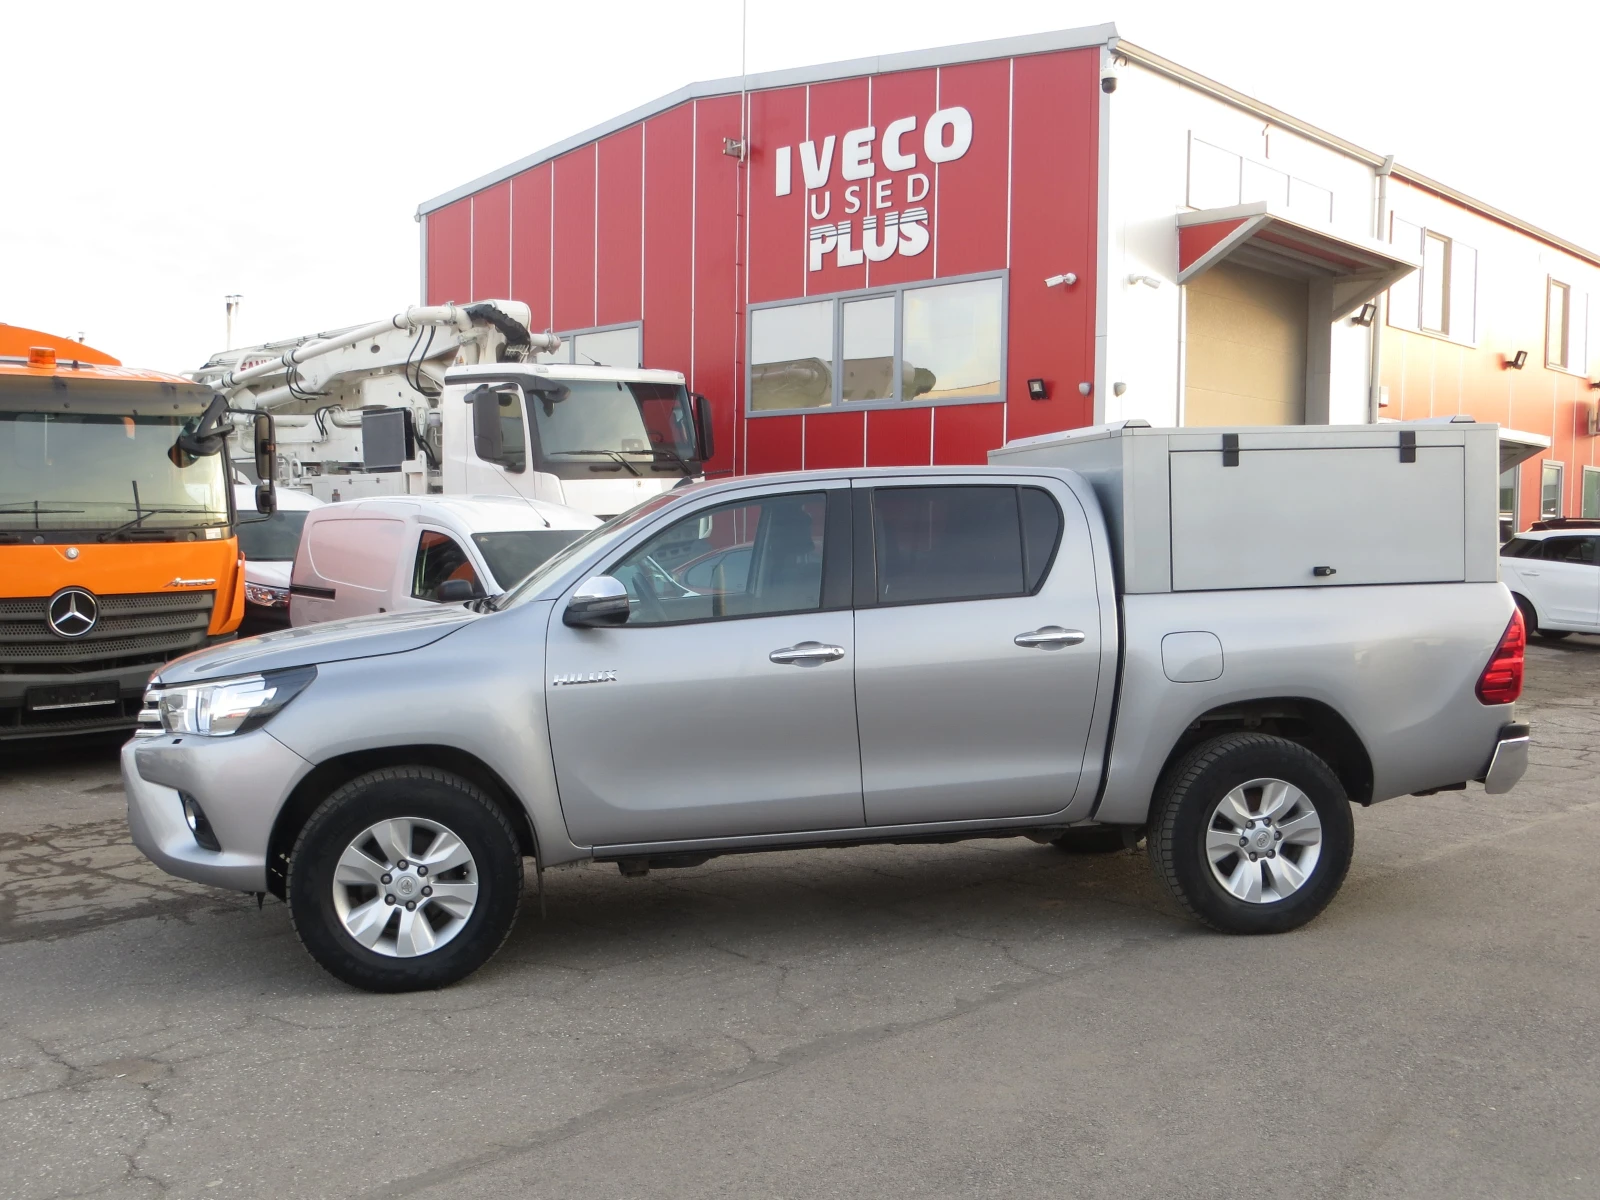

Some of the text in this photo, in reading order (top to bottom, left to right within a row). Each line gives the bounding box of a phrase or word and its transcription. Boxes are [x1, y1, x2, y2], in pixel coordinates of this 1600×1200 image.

[775, 106, 973, 197] IVECO
[811, 173, 930, 220] USED
[809, 207, 930, 272] PLUS
[553, 669, 617, 686] HILUX
